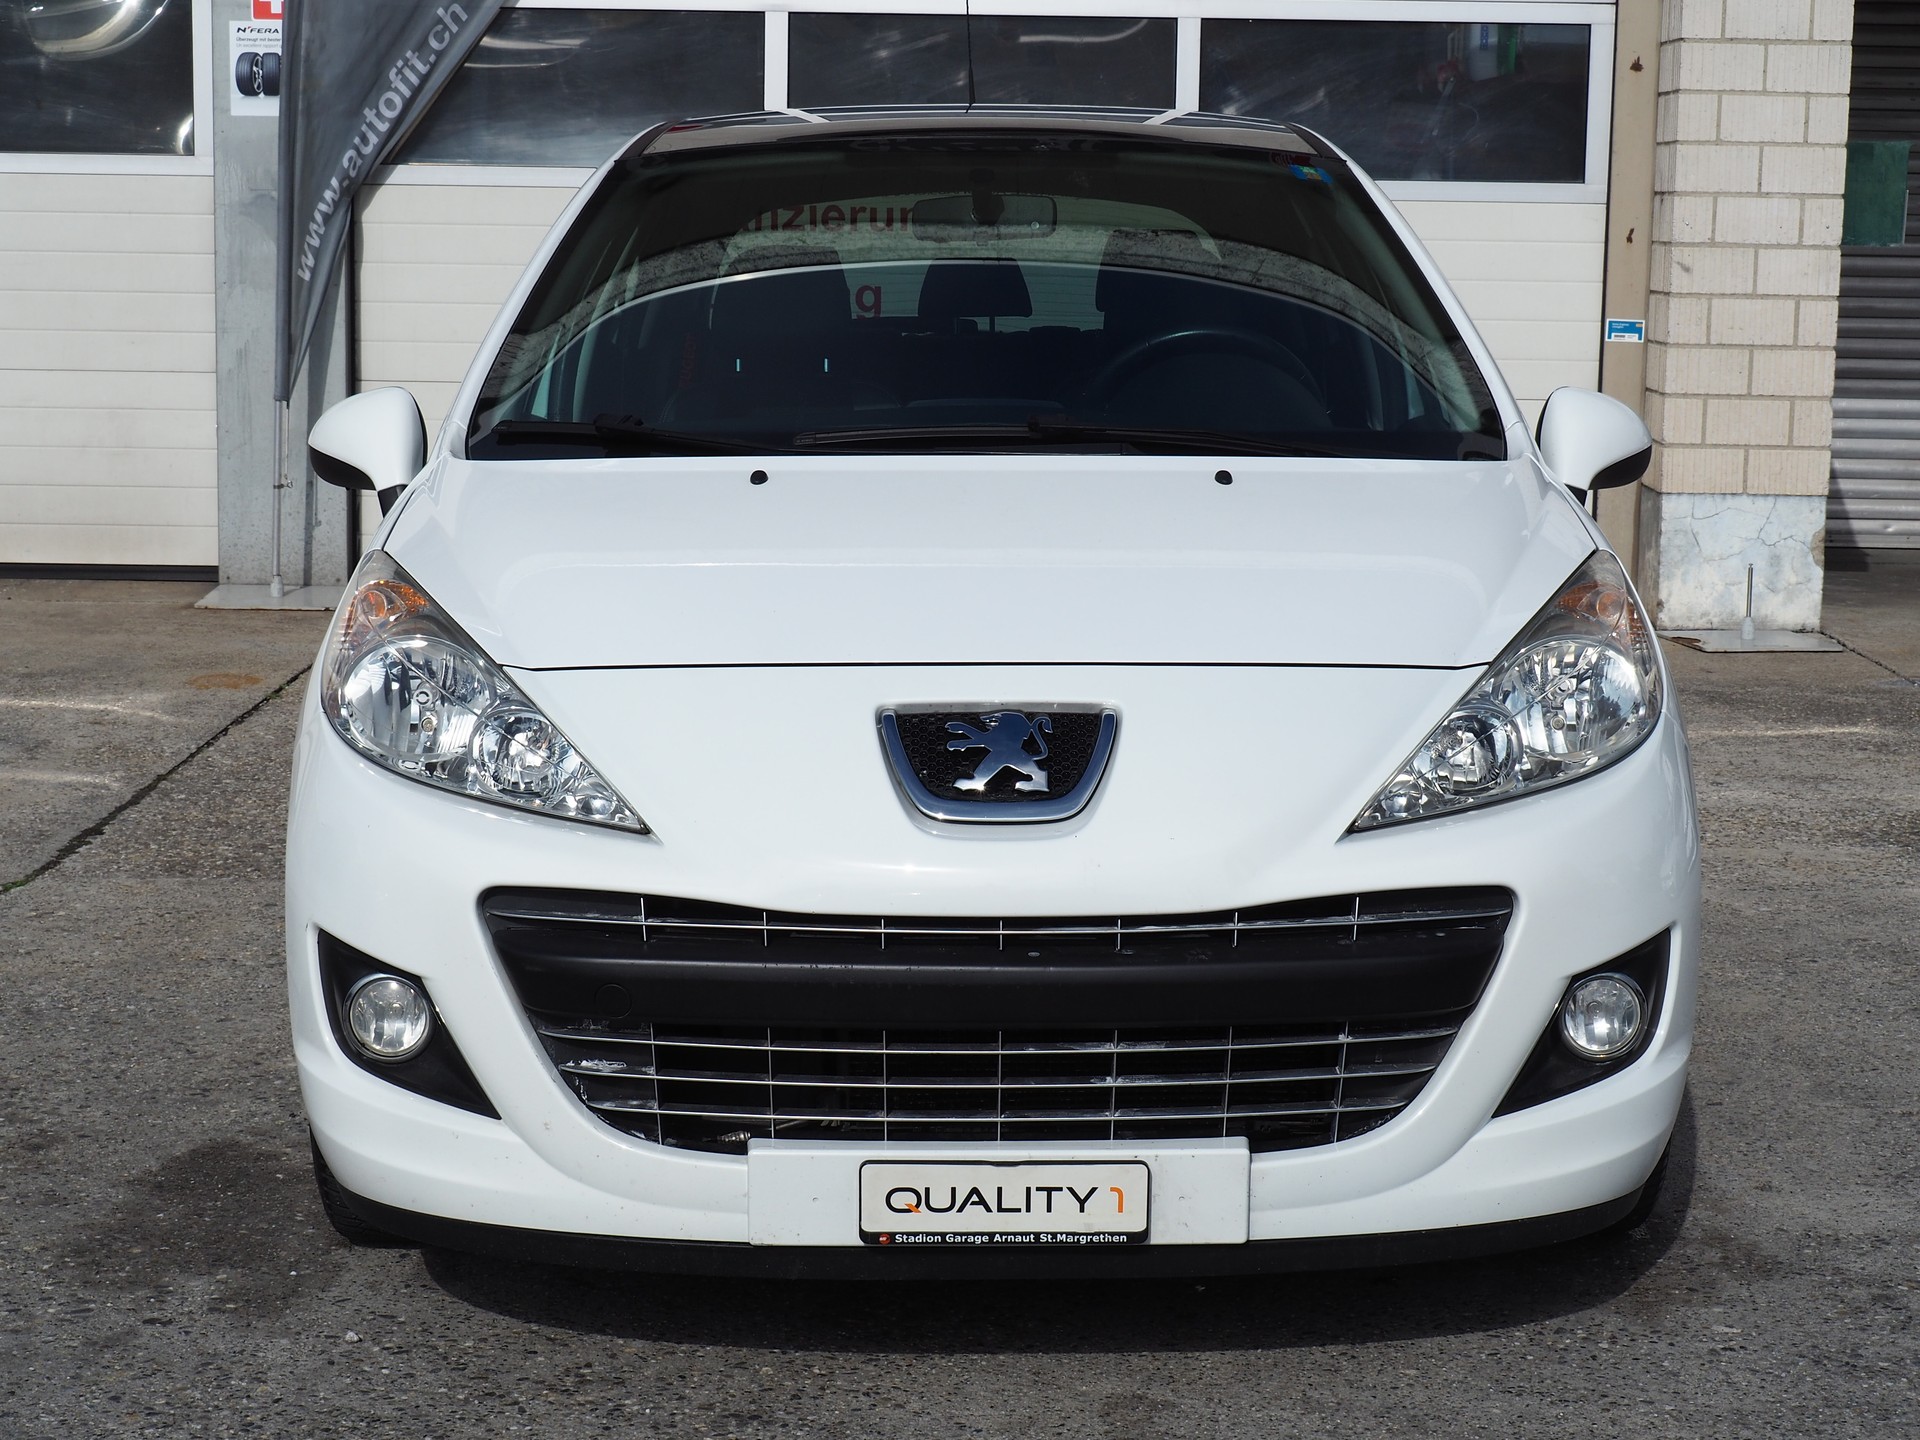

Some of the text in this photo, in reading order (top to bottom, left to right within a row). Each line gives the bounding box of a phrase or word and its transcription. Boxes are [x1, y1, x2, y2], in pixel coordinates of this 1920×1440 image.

[297, 2, 468, 281] www.autofit.ch
[885, 1186, 1124, 1214] QUALITY 1
[894, 1233, 943, 1244] Stadion
[945, 1233, 990, 1246] Garage
[993, 1233, 1035, 1244] Arnaut
[1039, 1233, 1127, 1246] St.Margrethen
